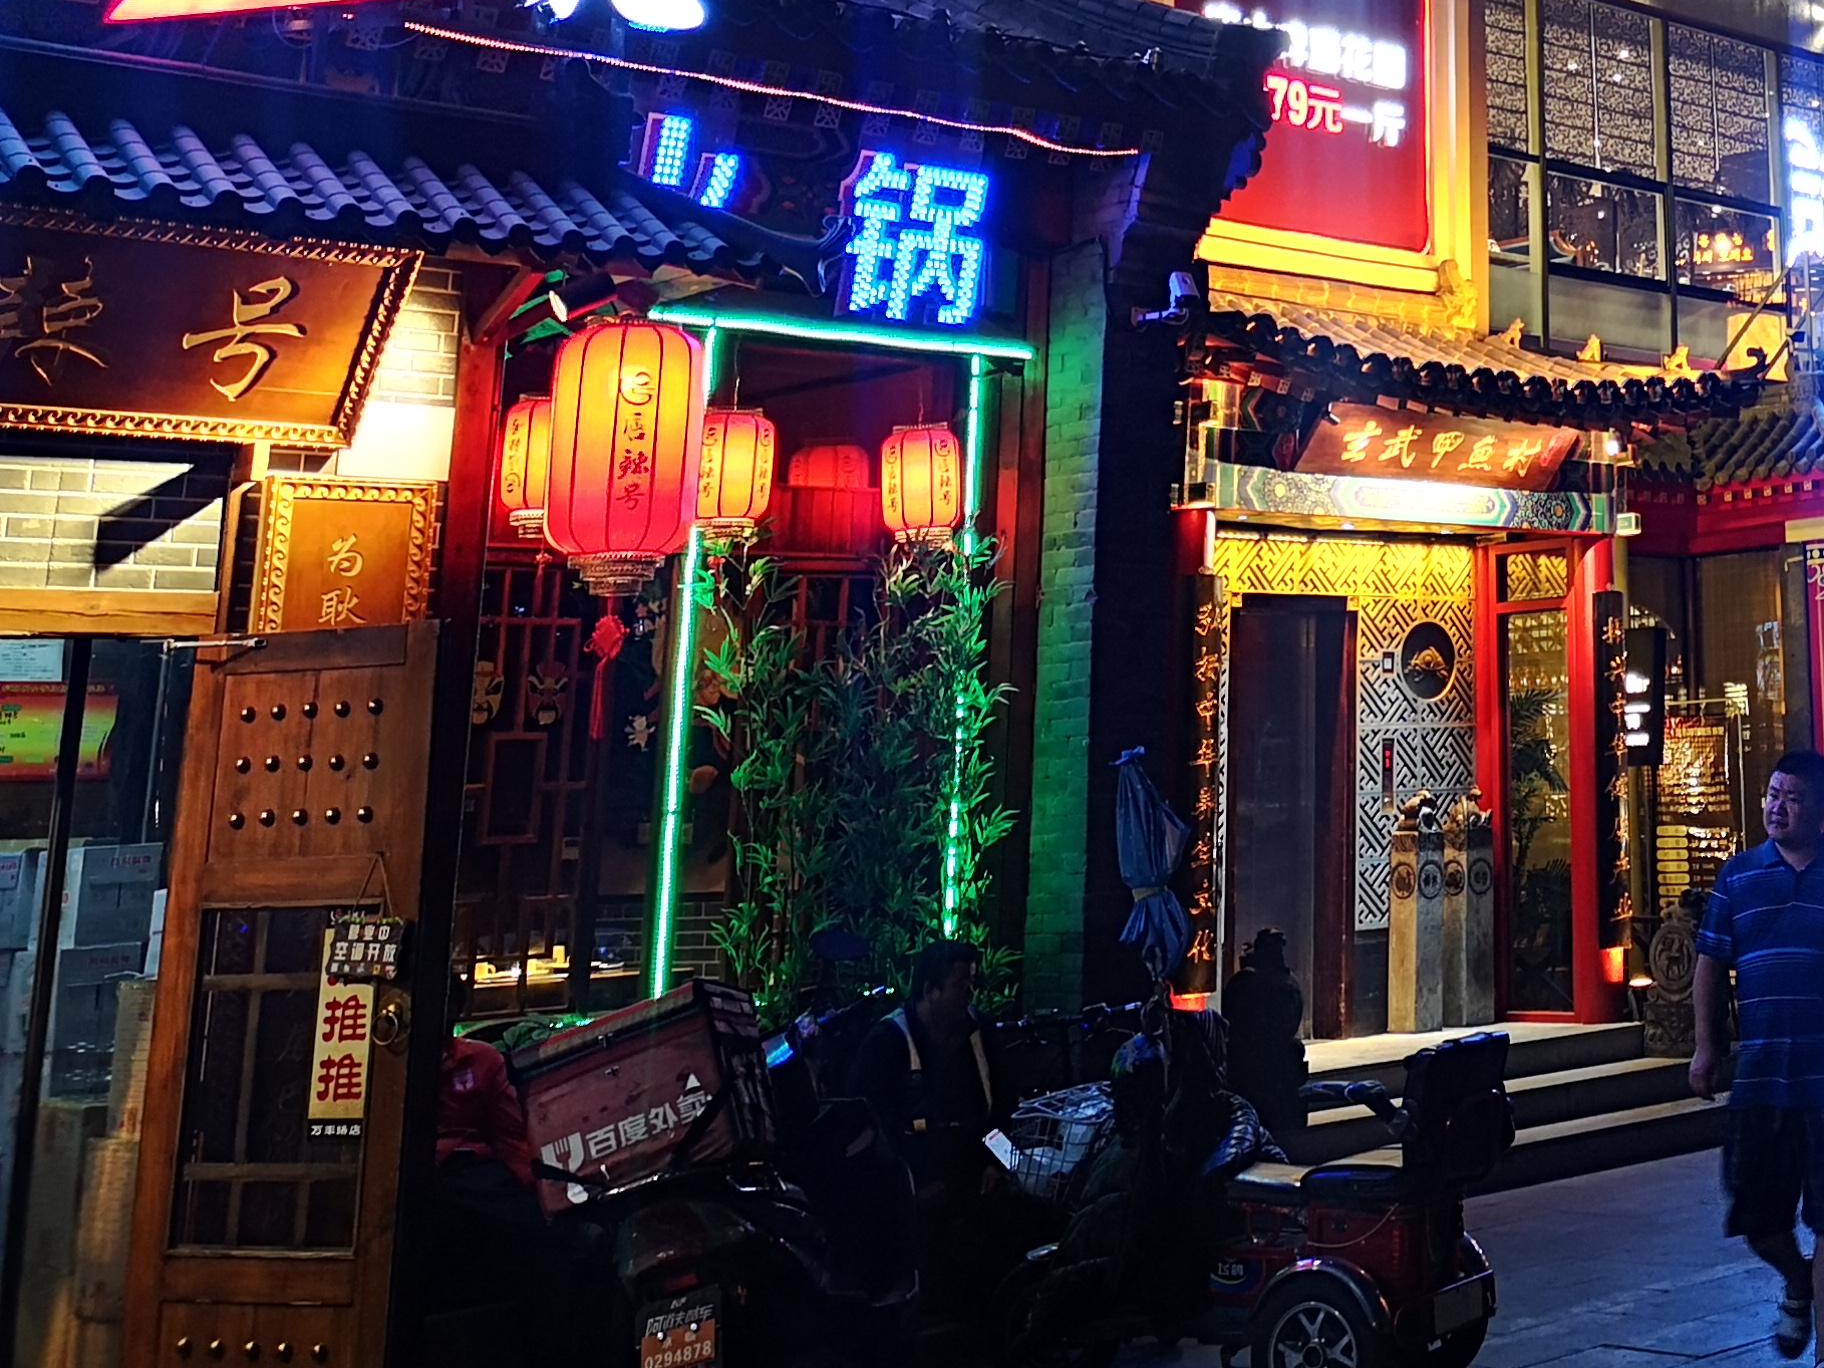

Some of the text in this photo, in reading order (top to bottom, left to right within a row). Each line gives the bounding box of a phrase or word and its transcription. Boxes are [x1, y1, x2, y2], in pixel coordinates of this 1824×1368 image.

[1264, 76, 1406, 147] 79元一斤
[1341, 420, 1541, 478] 玄武甲鱼村
[333, 941, 397, 963] 空调开放
[586, 1091, 713, 1159] 百度外卖
